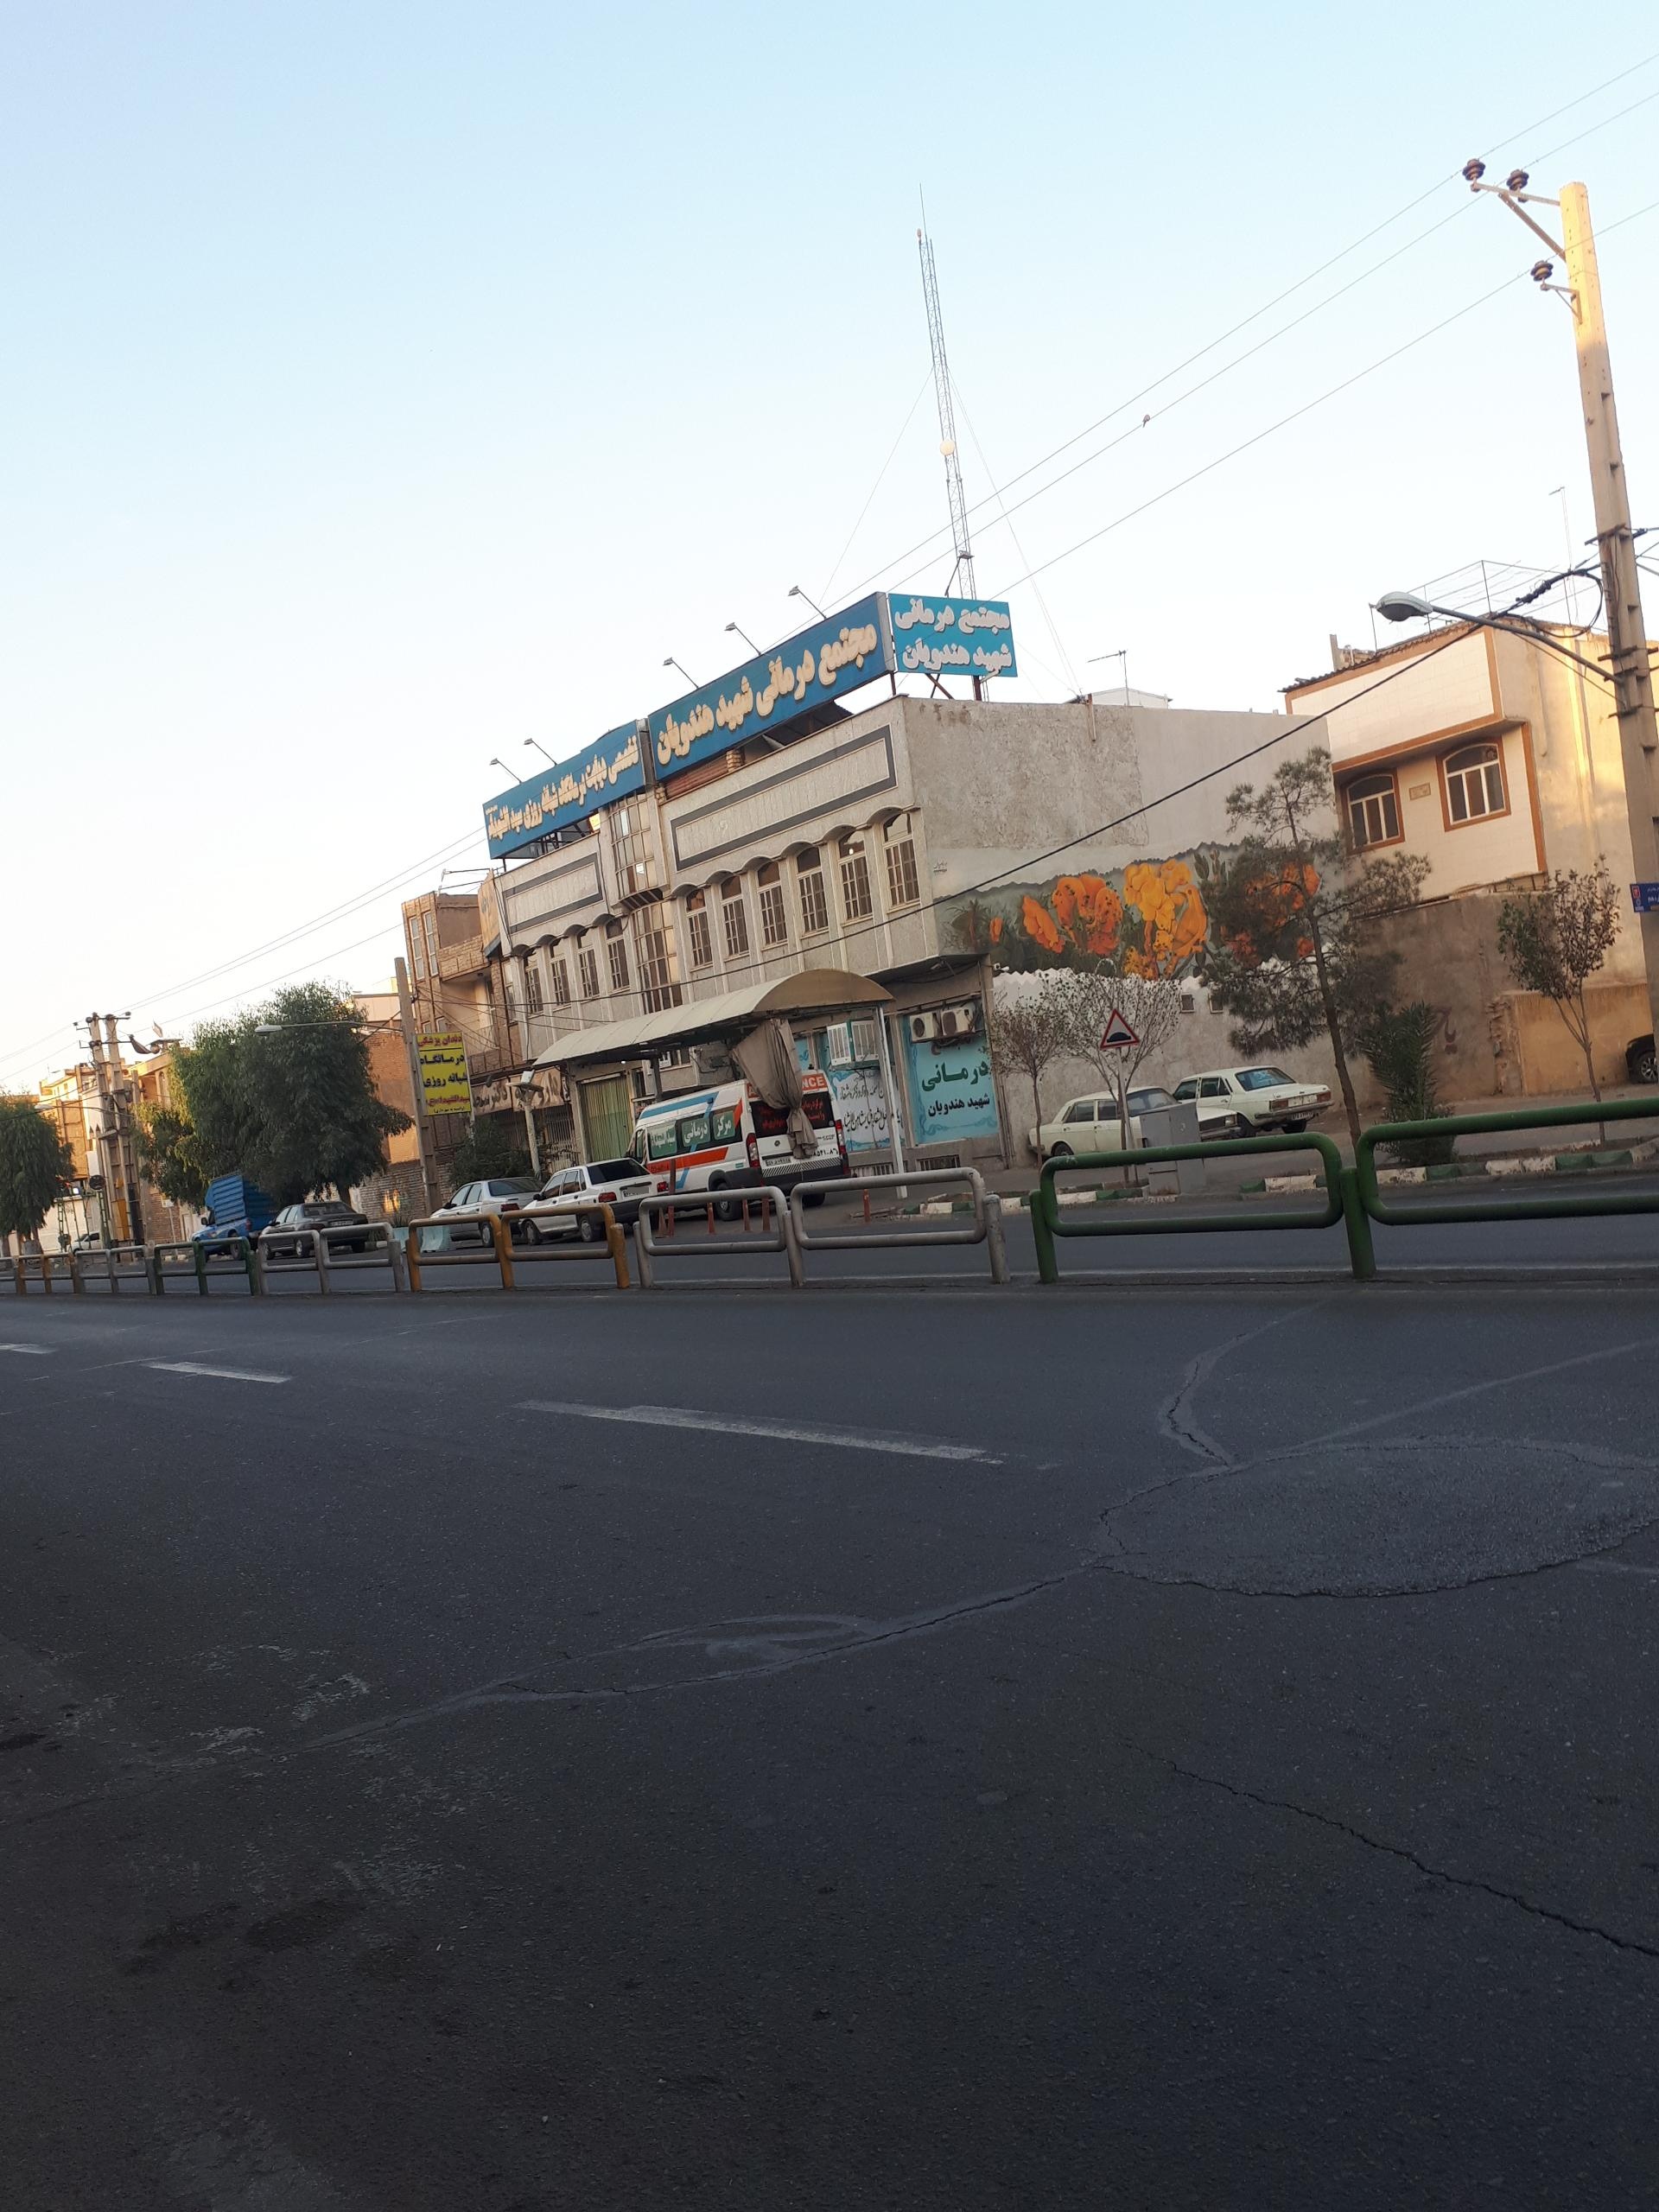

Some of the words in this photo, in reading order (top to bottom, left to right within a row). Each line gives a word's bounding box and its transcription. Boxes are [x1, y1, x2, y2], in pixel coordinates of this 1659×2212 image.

[894, 598, 955, 632] درمانی
[958, 607, 1010, 635] مجتمع
[817, 623, 877, 686] مجتمع
[902, 638, 970, 671] هندویان
[973, 643, 1012, 671] شهید
[755, 650, 815, 717] درمانی
[715, 676, 753, 730] شهید
[657, 703, 715, 766] هندویان
[419, 1053, 465, 1066] درمانگاه
[423, 1076, 447, 1089] روزی
[921, 1060, 989, 1092] درمانی
[928, 1098, 965, 1117] هندویان
[967, 1093, 991, 1110] شهید
[683, 1121, 709, 1144] درمانی
[716, 1115, 733, 1137] مرکز
